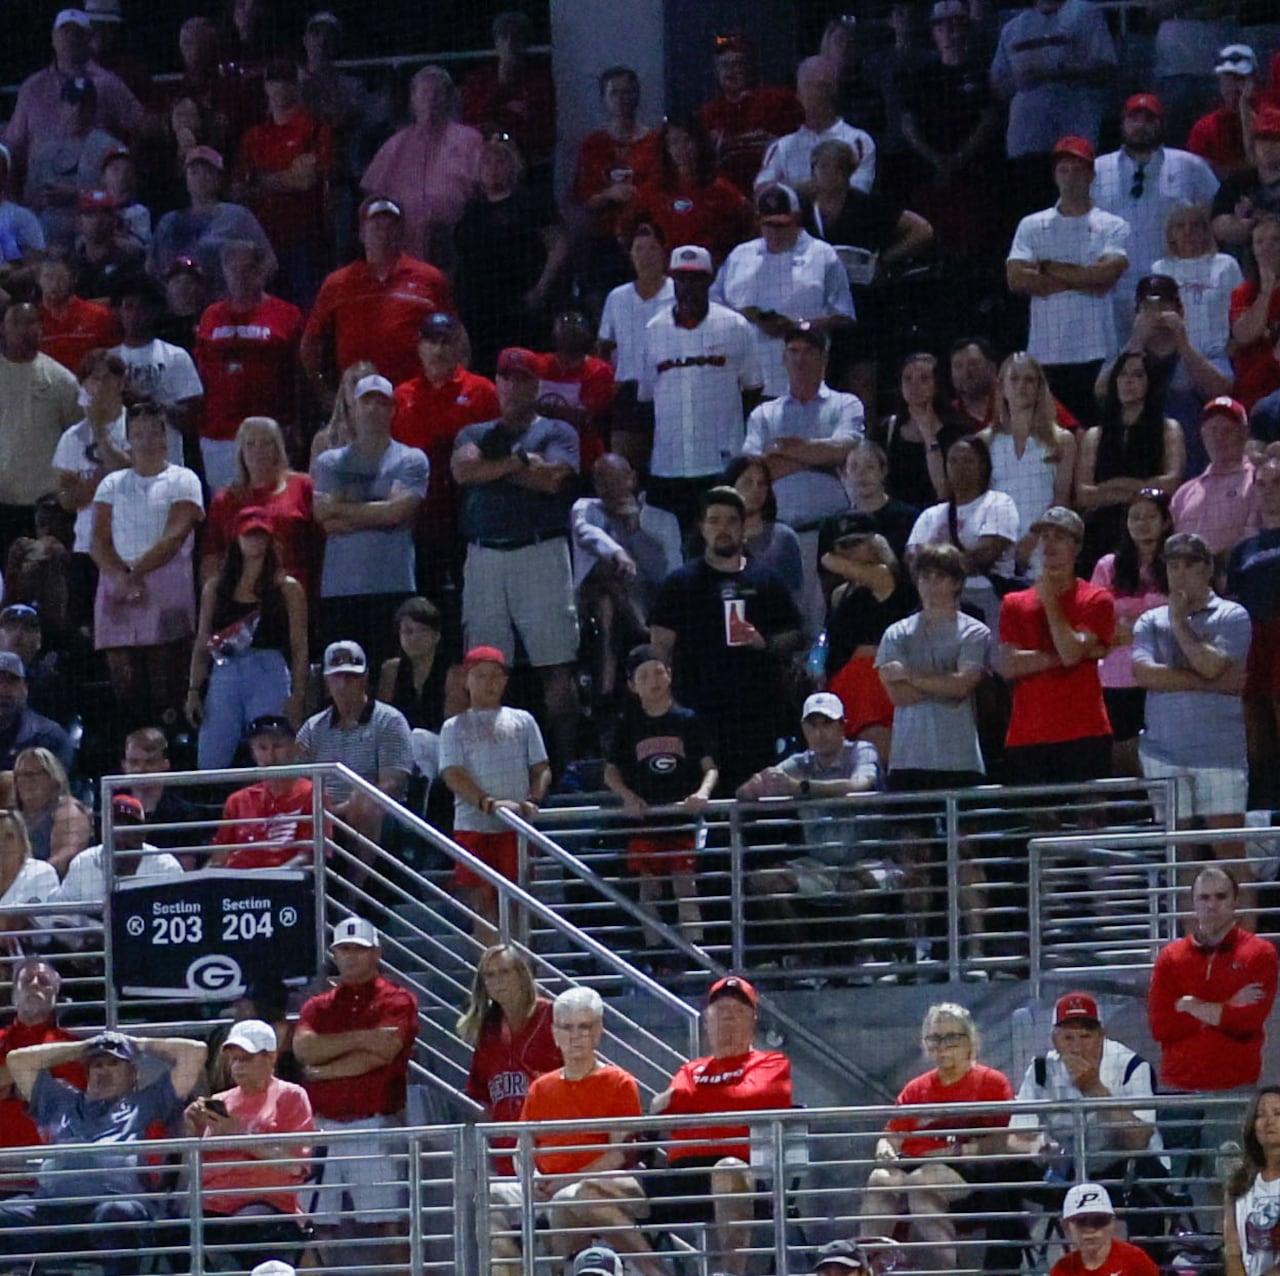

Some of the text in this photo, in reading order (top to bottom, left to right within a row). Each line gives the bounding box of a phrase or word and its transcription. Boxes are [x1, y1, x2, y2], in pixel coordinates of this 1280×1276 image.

[649, 753, 679, 776] G
[152, 900, 201, 915] Section
[222, 897, 271, 911] Section
[152, 918, 203, 945] 203
[222, 913, 274, 941] 204
[192, 960, 237, 992] G
[487, 1071, 529, 1102] GEOR
[1077, 1193, 1098, 1209] P
